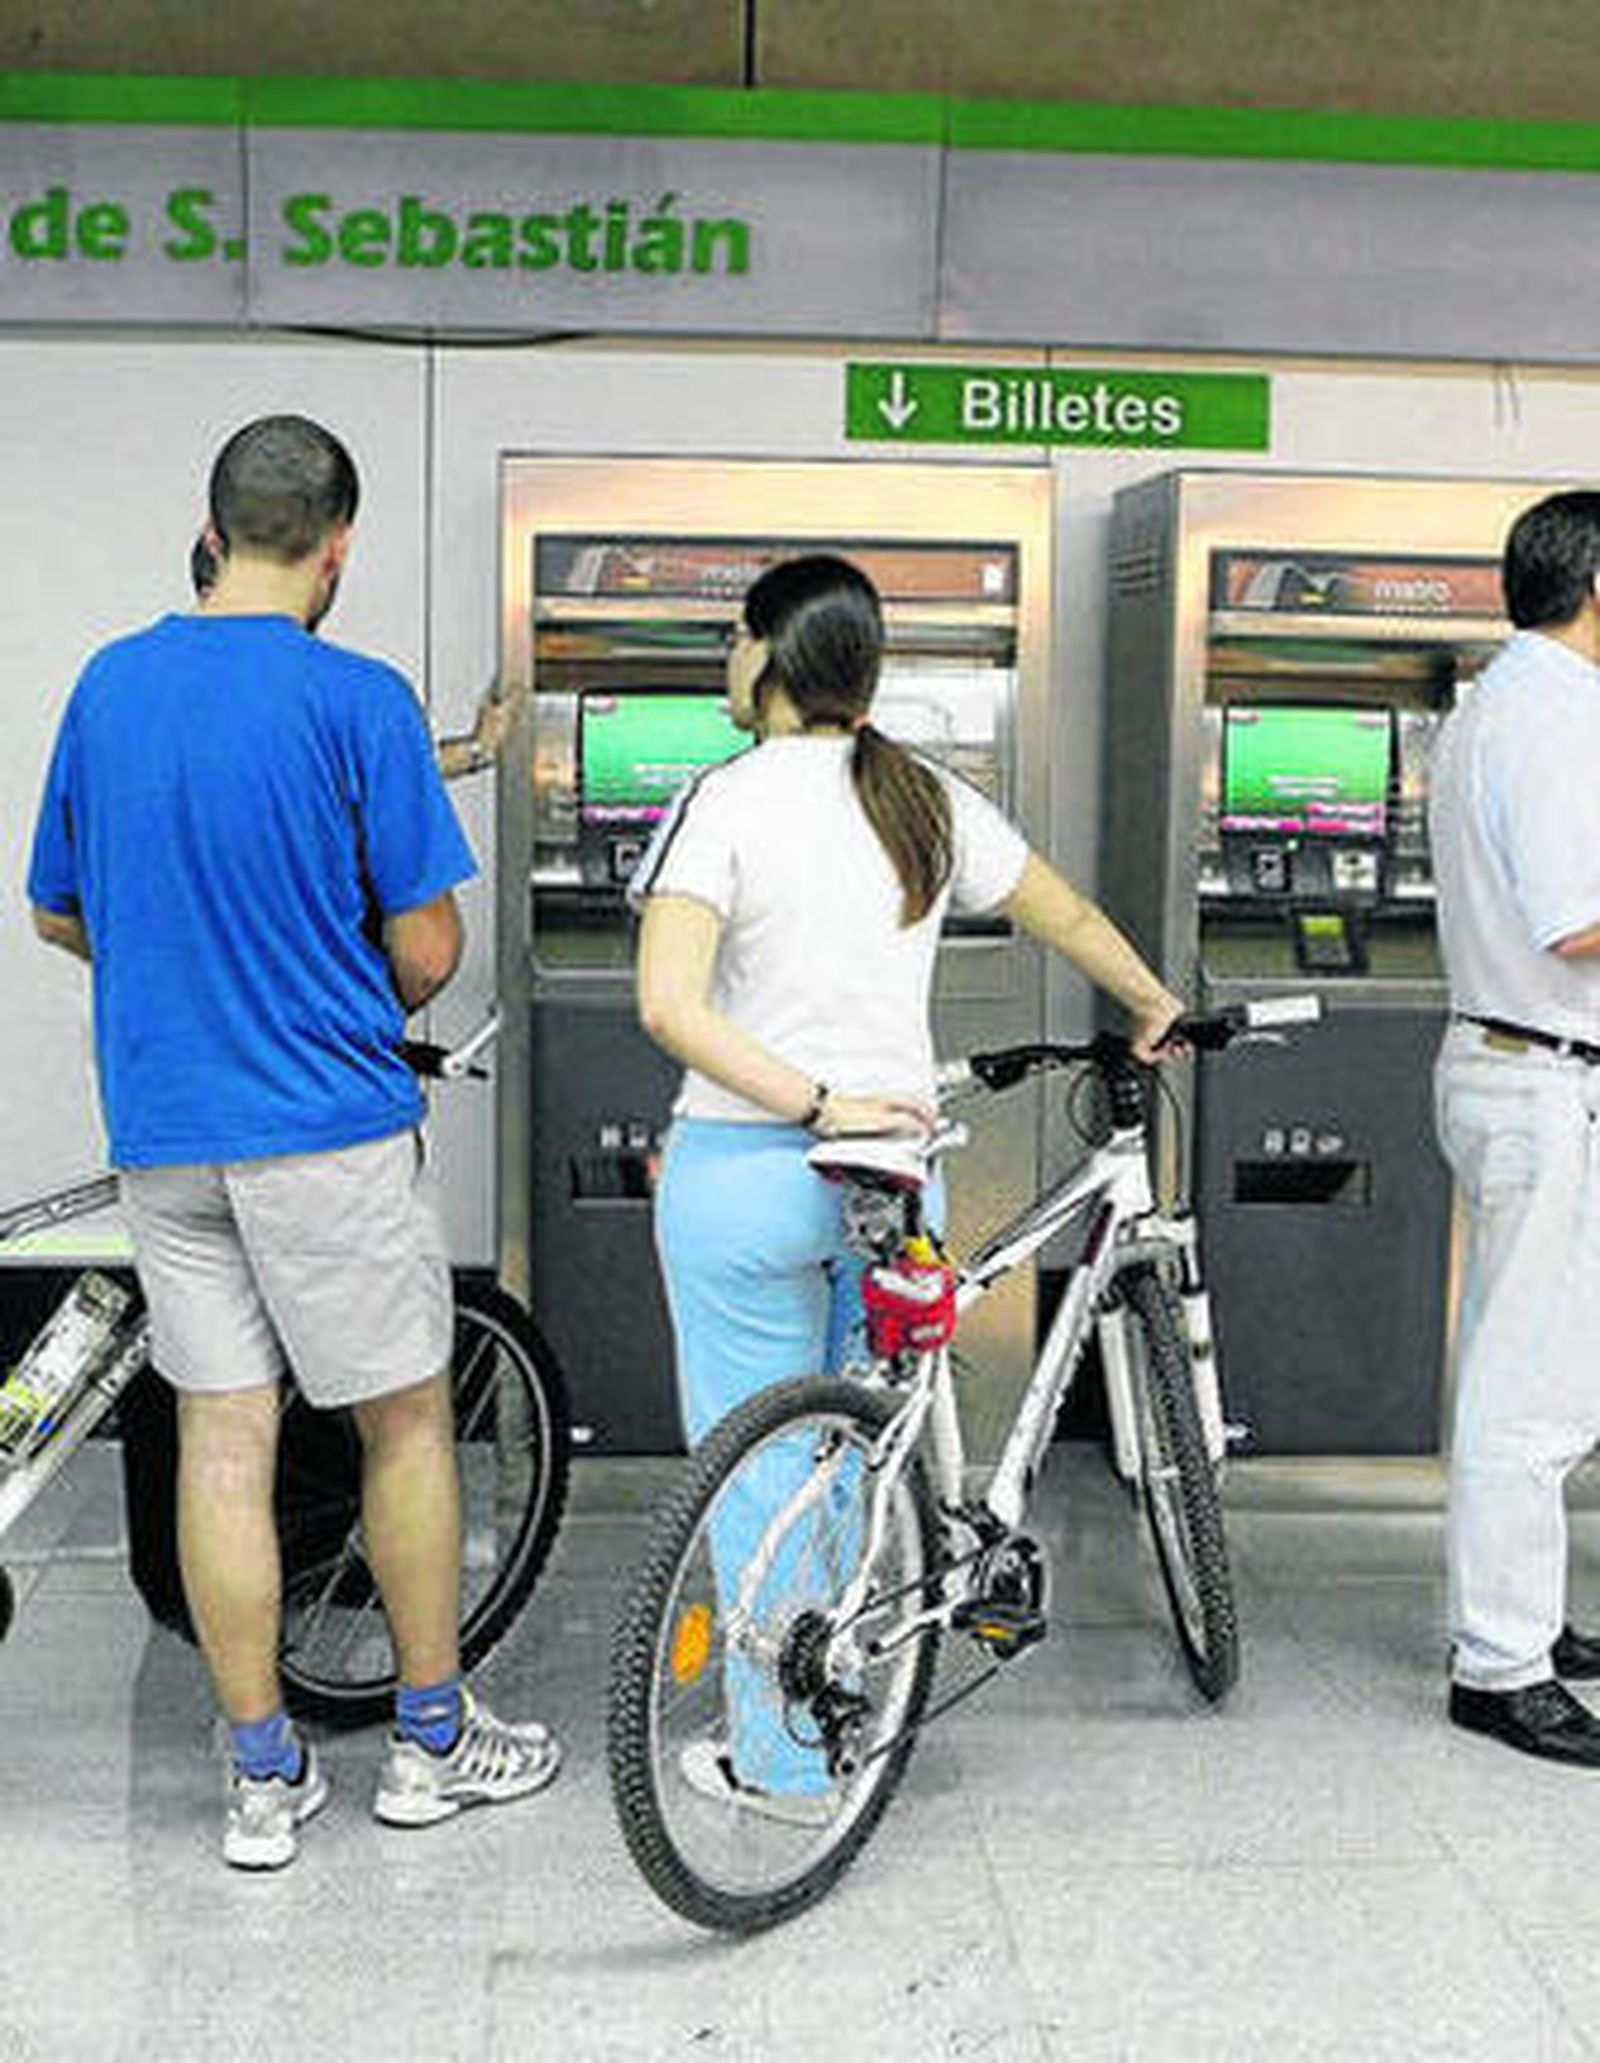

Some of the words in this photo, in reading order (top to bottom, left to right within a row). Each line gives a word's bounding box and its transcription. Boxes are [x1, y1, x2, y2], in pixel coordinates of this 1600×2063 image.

[8, 187, 130, 262] de
[164, 188, 247, 263] S.
[282, 191, 751, 275] Sebastián
[962, 379, 1183, 435] Billetes
